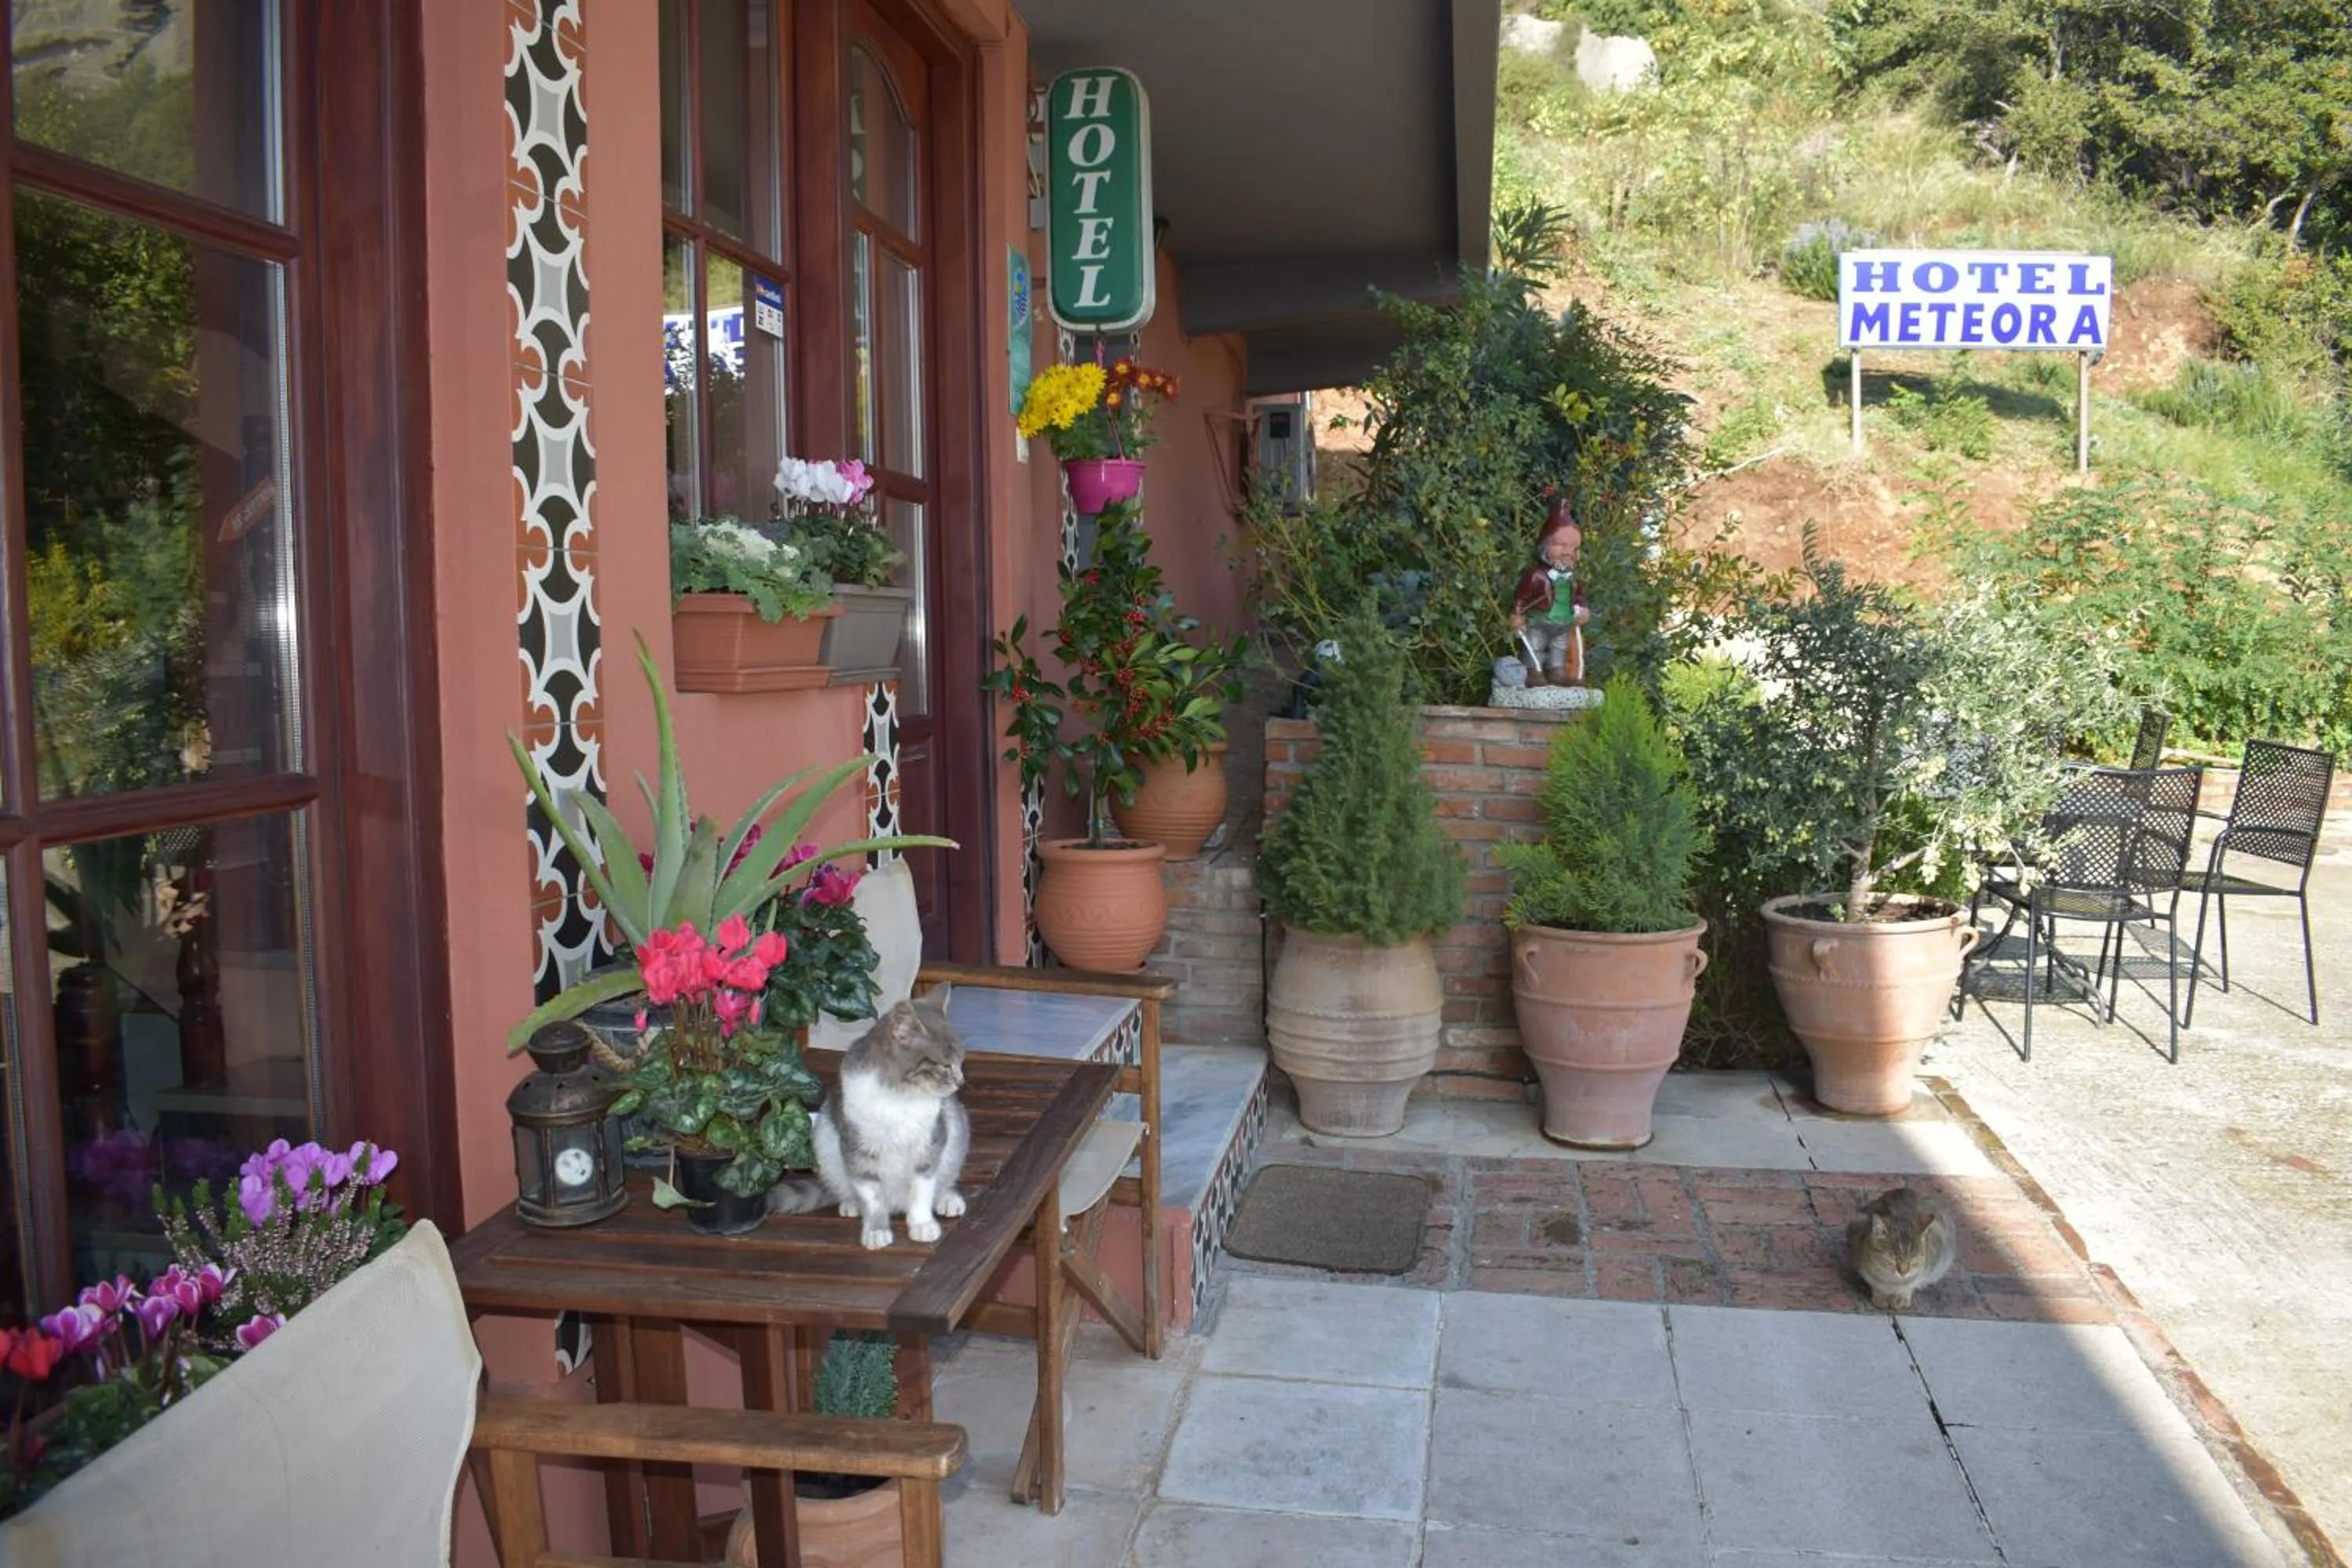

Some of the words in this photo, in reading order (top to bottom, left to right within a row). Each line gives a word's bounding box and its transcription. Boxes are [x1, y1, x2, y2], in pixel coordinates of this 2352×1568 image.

[1063, 76, 1118, 308] HOTEL
[1853, 261, 2105, 295] HOTEL
[1849, 302, 2103, 344] METEORA
